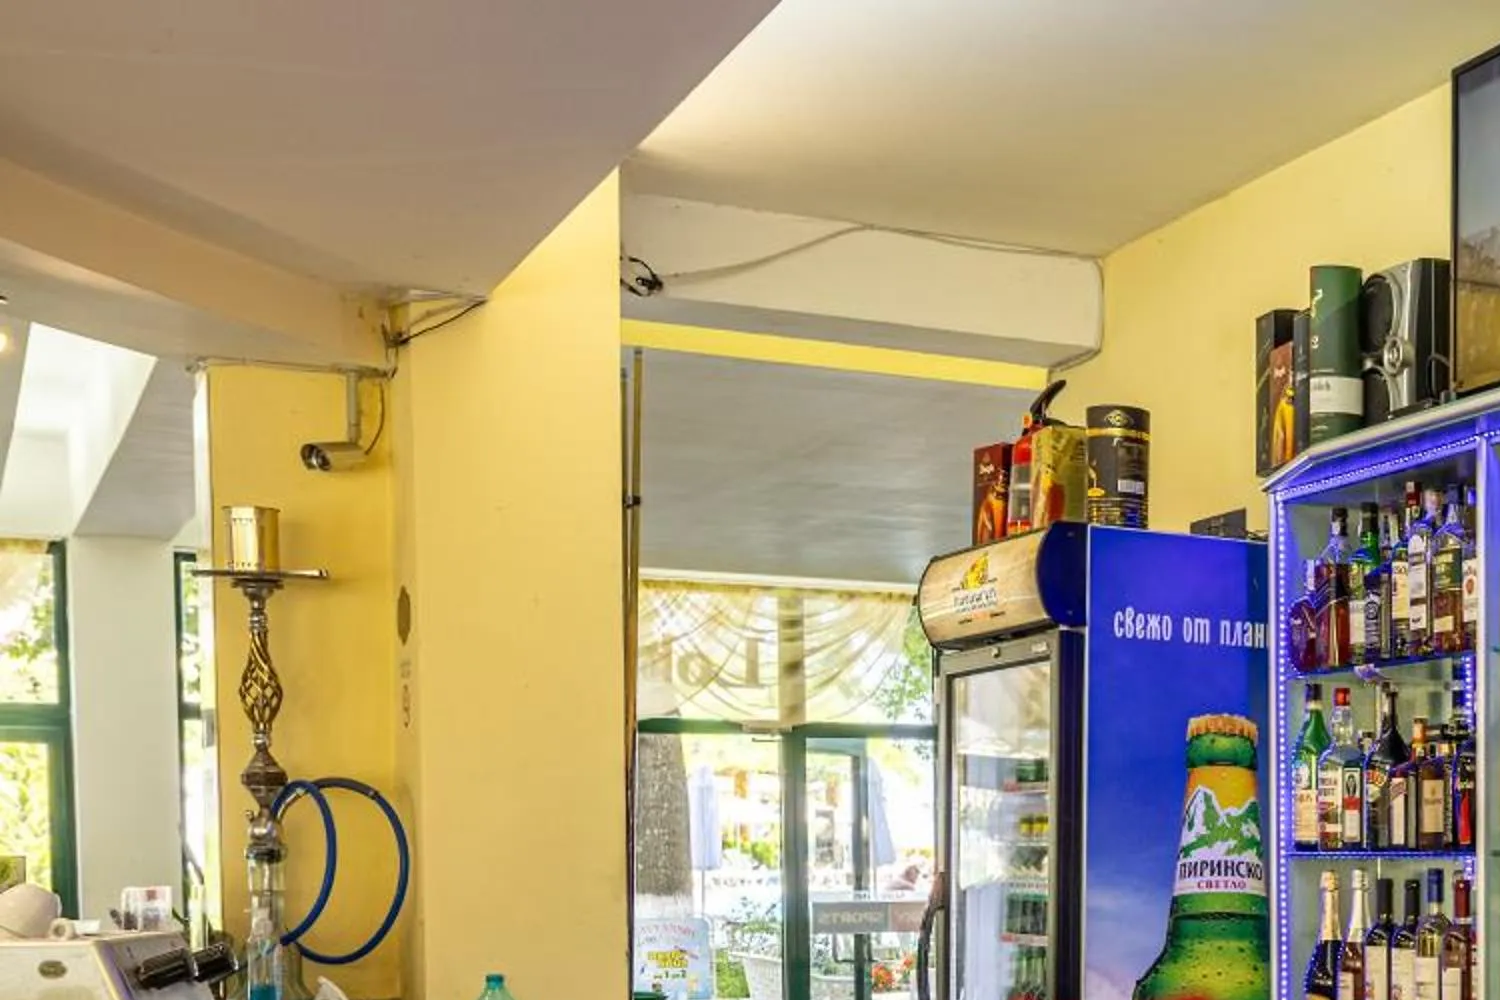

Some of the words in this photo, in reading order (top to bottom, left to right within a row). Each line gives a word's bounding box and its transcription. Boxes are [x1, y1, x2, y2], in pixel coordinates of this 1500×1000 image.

[1113, 606, 1173, 641] свежо
[1183, 616, 1211, 645] от
[1179, 859, 1263, 881] ПИРИНСКО
